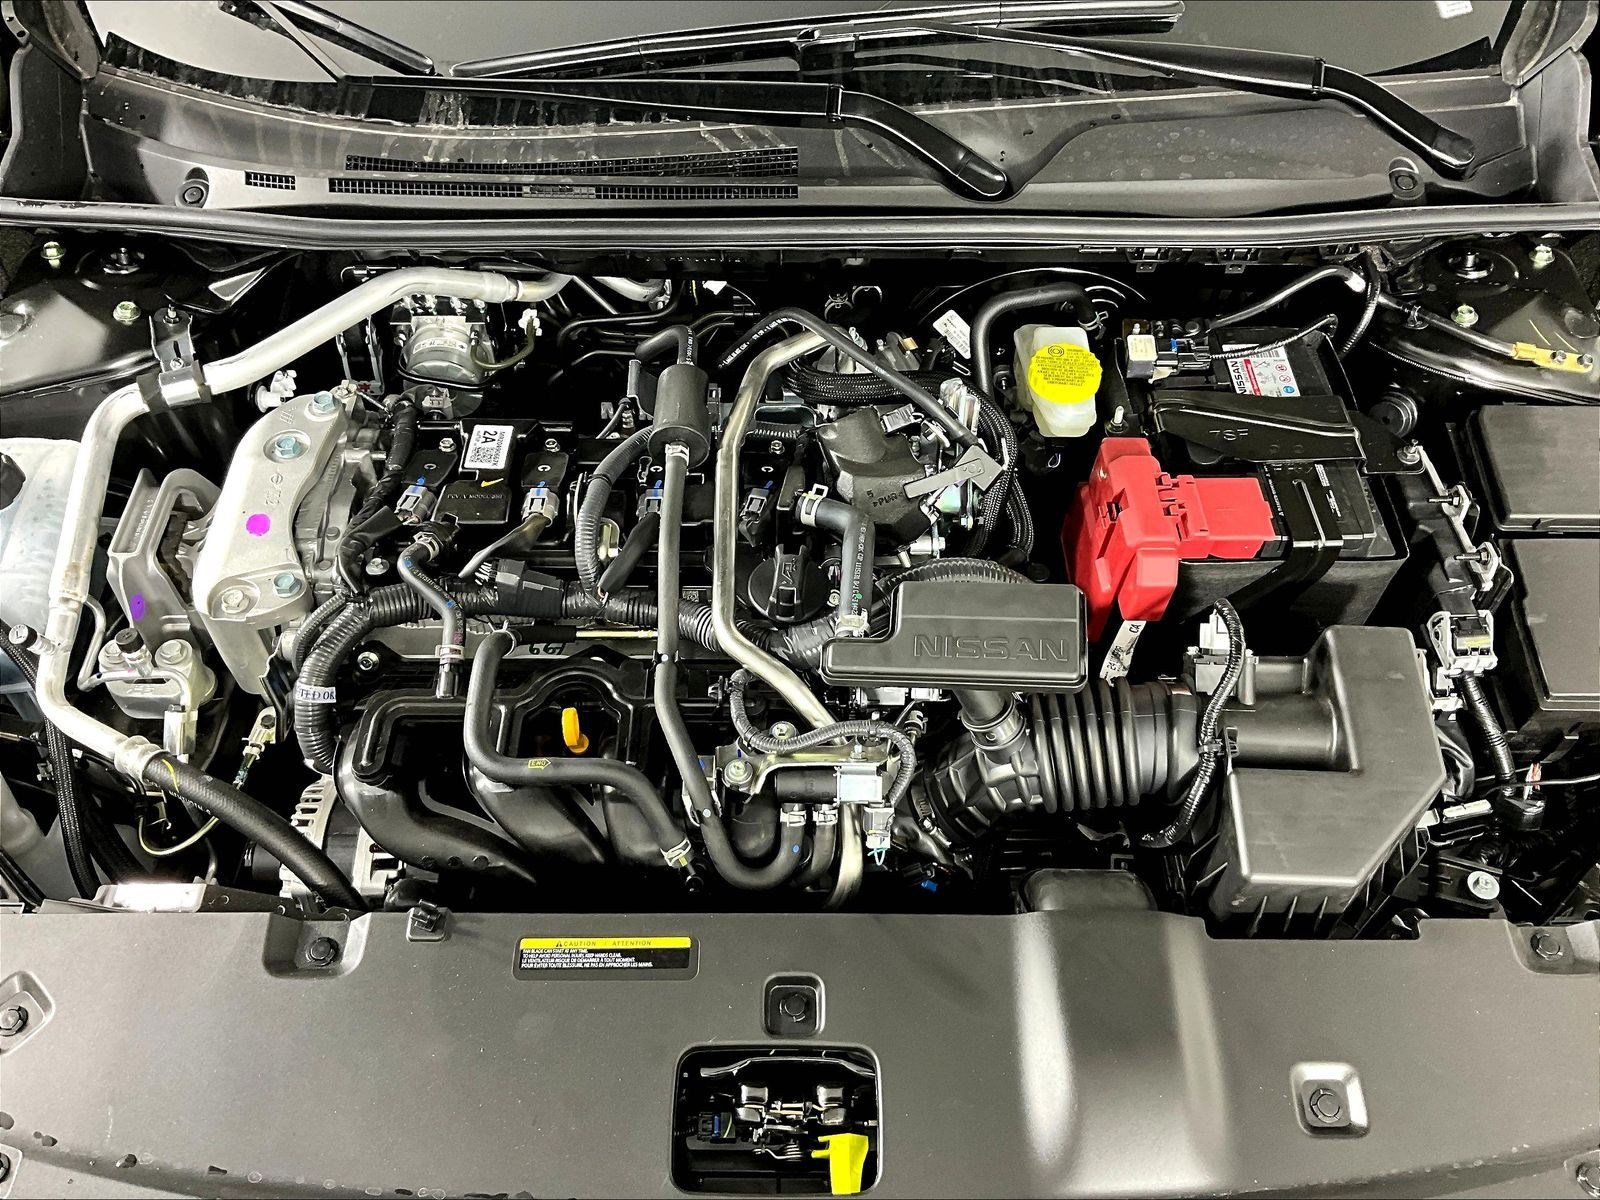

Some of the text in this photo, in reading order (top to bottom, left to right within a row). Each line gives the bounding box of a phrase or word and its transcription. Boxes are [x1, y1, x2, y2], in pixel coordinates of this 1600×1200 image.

[1230, 360, 1247, 394] NISSAN
[482, 430, 498, 444] 2A
[913, 634, 1068, 662] NISSAN
